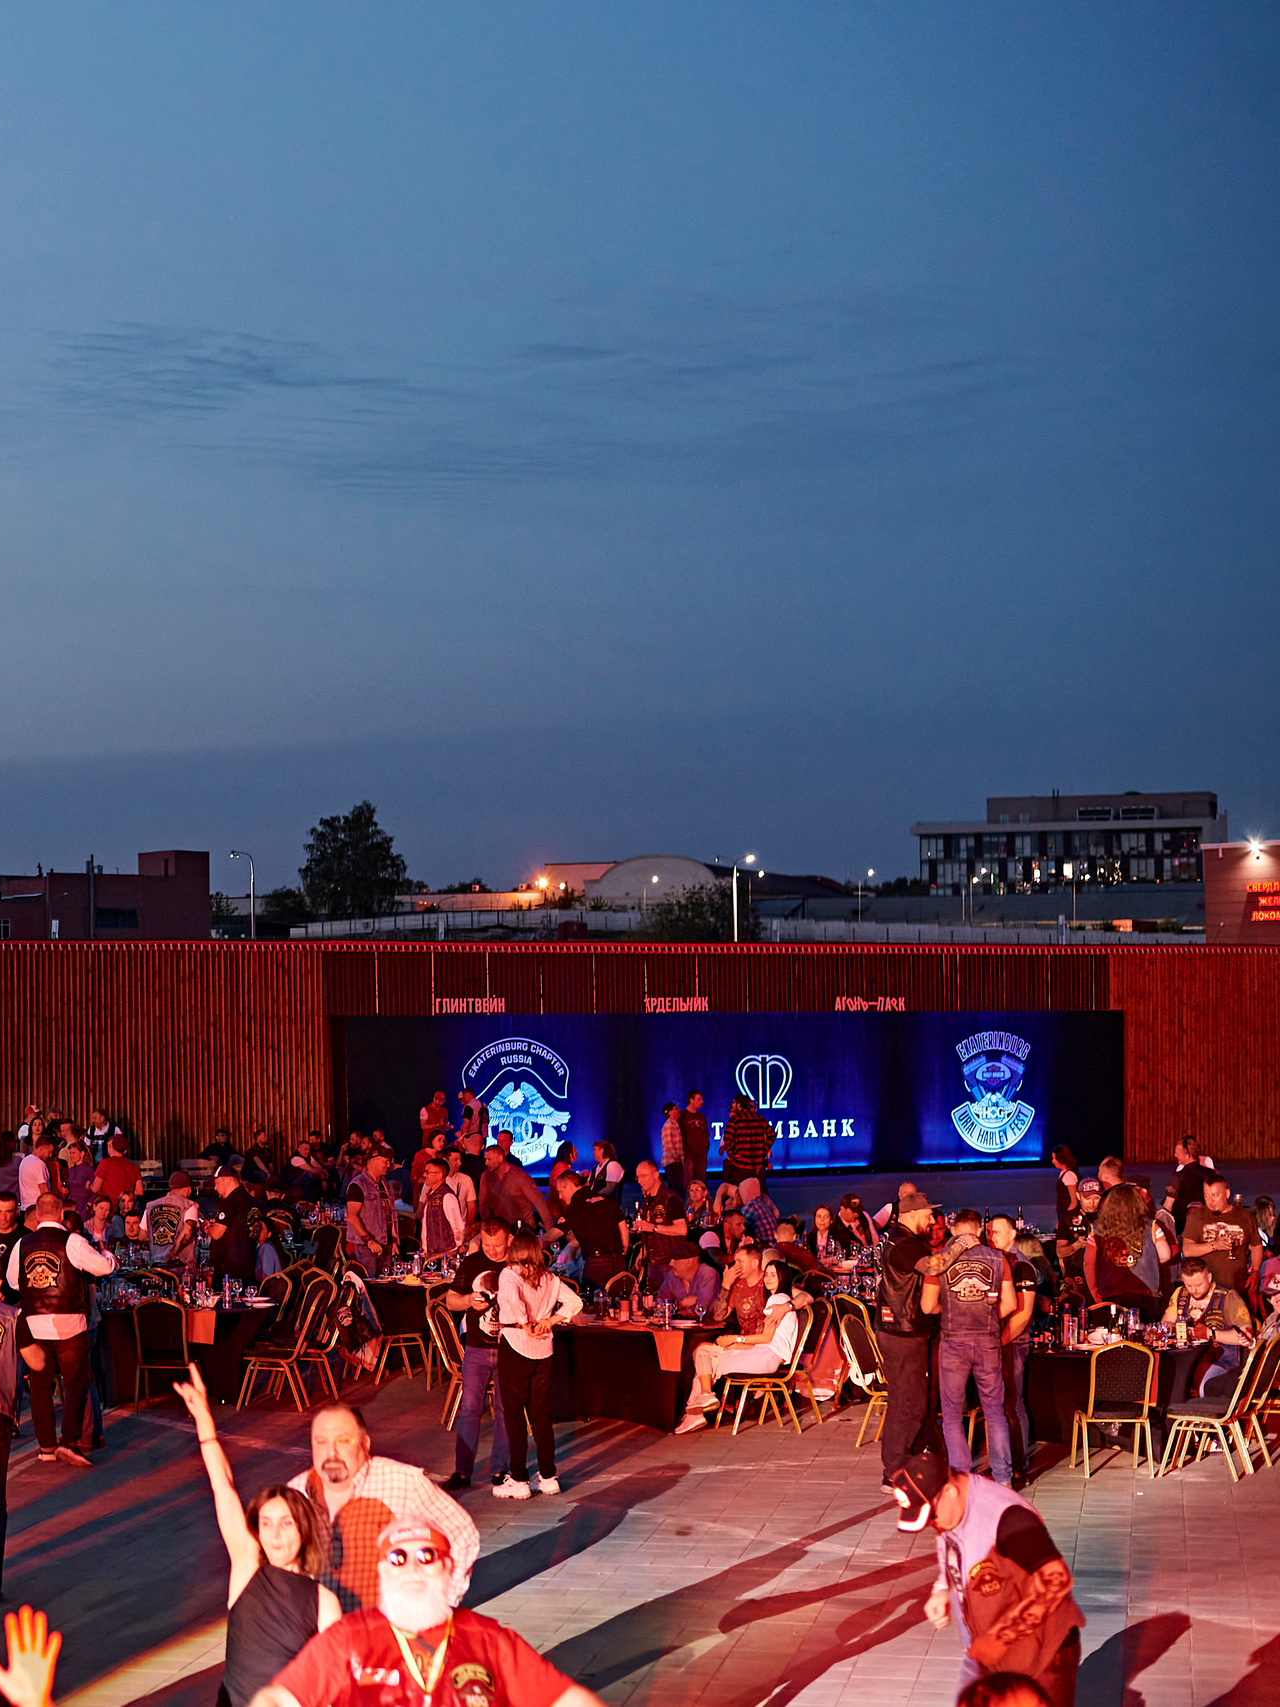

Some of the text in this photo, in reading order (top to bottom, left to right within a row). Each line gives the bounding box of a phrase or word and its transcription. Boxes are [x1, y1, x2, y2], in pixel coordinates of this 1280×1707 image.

[1258, 895, 1280, 907] ЖЕЛ
[435, 994, 506, 1014] ГЛИНТВЕЙН
[955, 1030, 1031, 1063] EKATERINBURG
[468, 1041, 565, 1078] EKATERINBURG CHAPTER
[500, 1054, 533, 1066] RUSSIA
[982, 1106, 1004, 1119] HOG
[958, 1110, 1029, 1146] URAL HARLEY FEST
